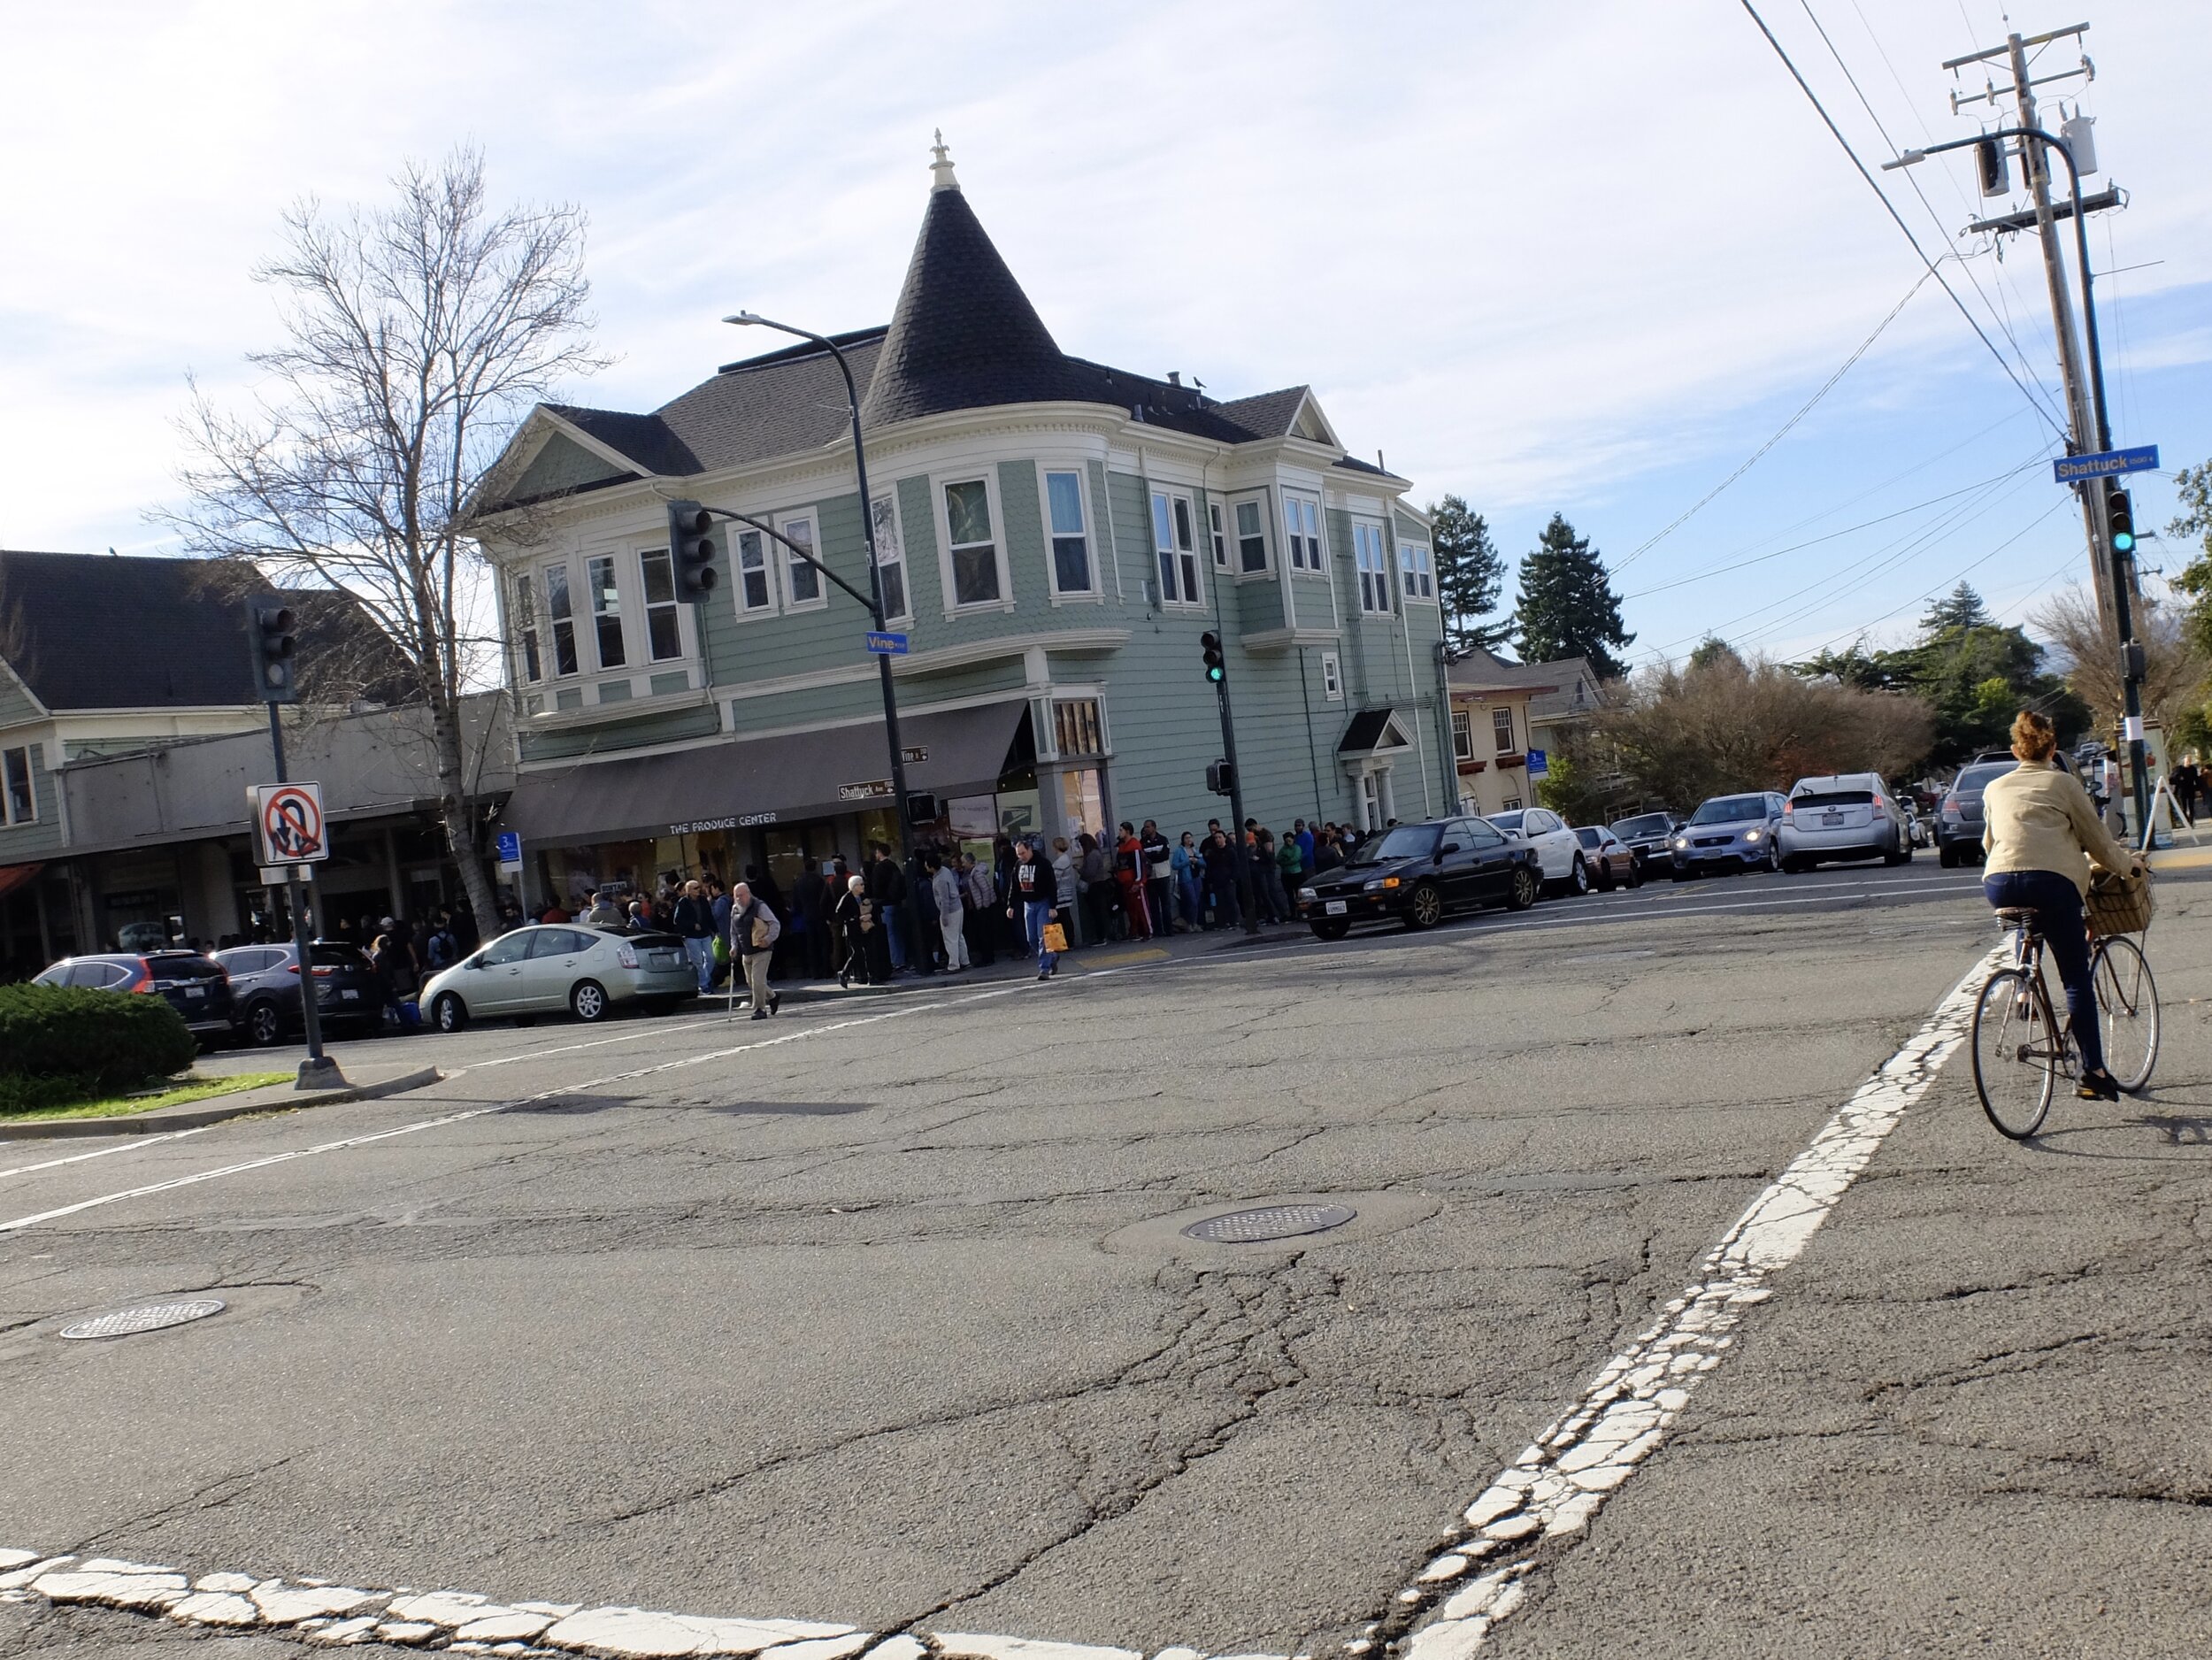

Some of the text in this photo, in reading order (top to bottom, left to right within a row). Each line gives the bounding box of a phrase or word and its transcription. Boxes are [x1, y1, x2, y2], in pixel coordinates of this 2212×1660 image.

[2058, 456, 2128, 477] Shattuck
[868, 636, 895, 649] Vine
[840, 784, 874, 799] Shattuck
[670, 812, 777, 834] THE PRODUCE CENTER
[502, 836, 509, 848] 3
